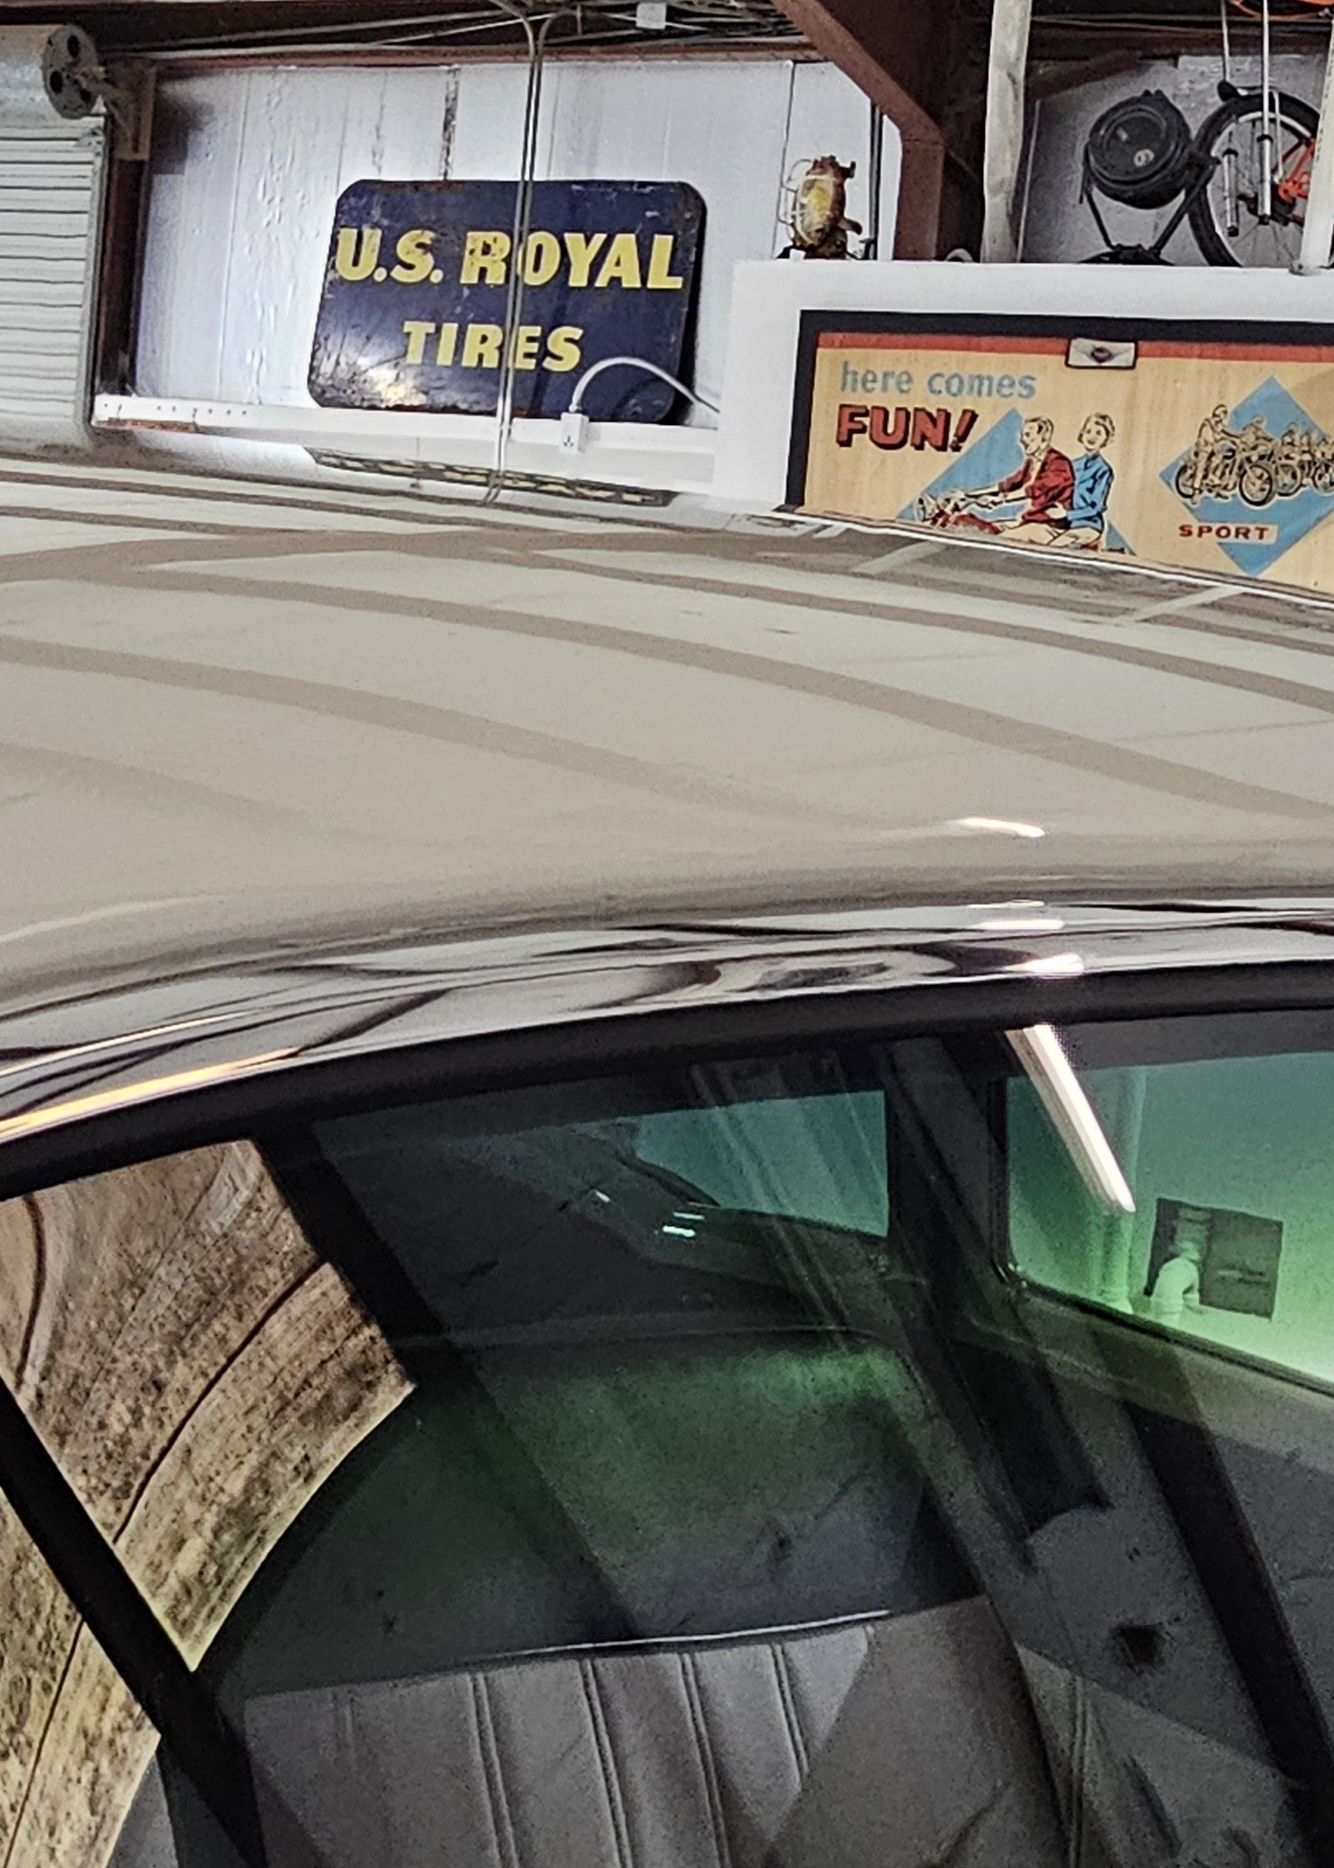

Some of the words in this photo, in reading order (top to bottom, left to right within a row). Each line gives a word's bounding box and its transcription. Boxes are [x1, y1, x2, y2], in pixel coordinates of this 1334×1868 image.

[334, 228, 444, 285] U.S.
[460, 231, 683, 289] ROYAL
[403, 321, 584, 372] TIRES
[841, 361, 913, 394] here
[928, 372, 1037, 399] comes
[836, 404, 978, 452] FUN!
[1178, 524, 1268, 540] SPORT
